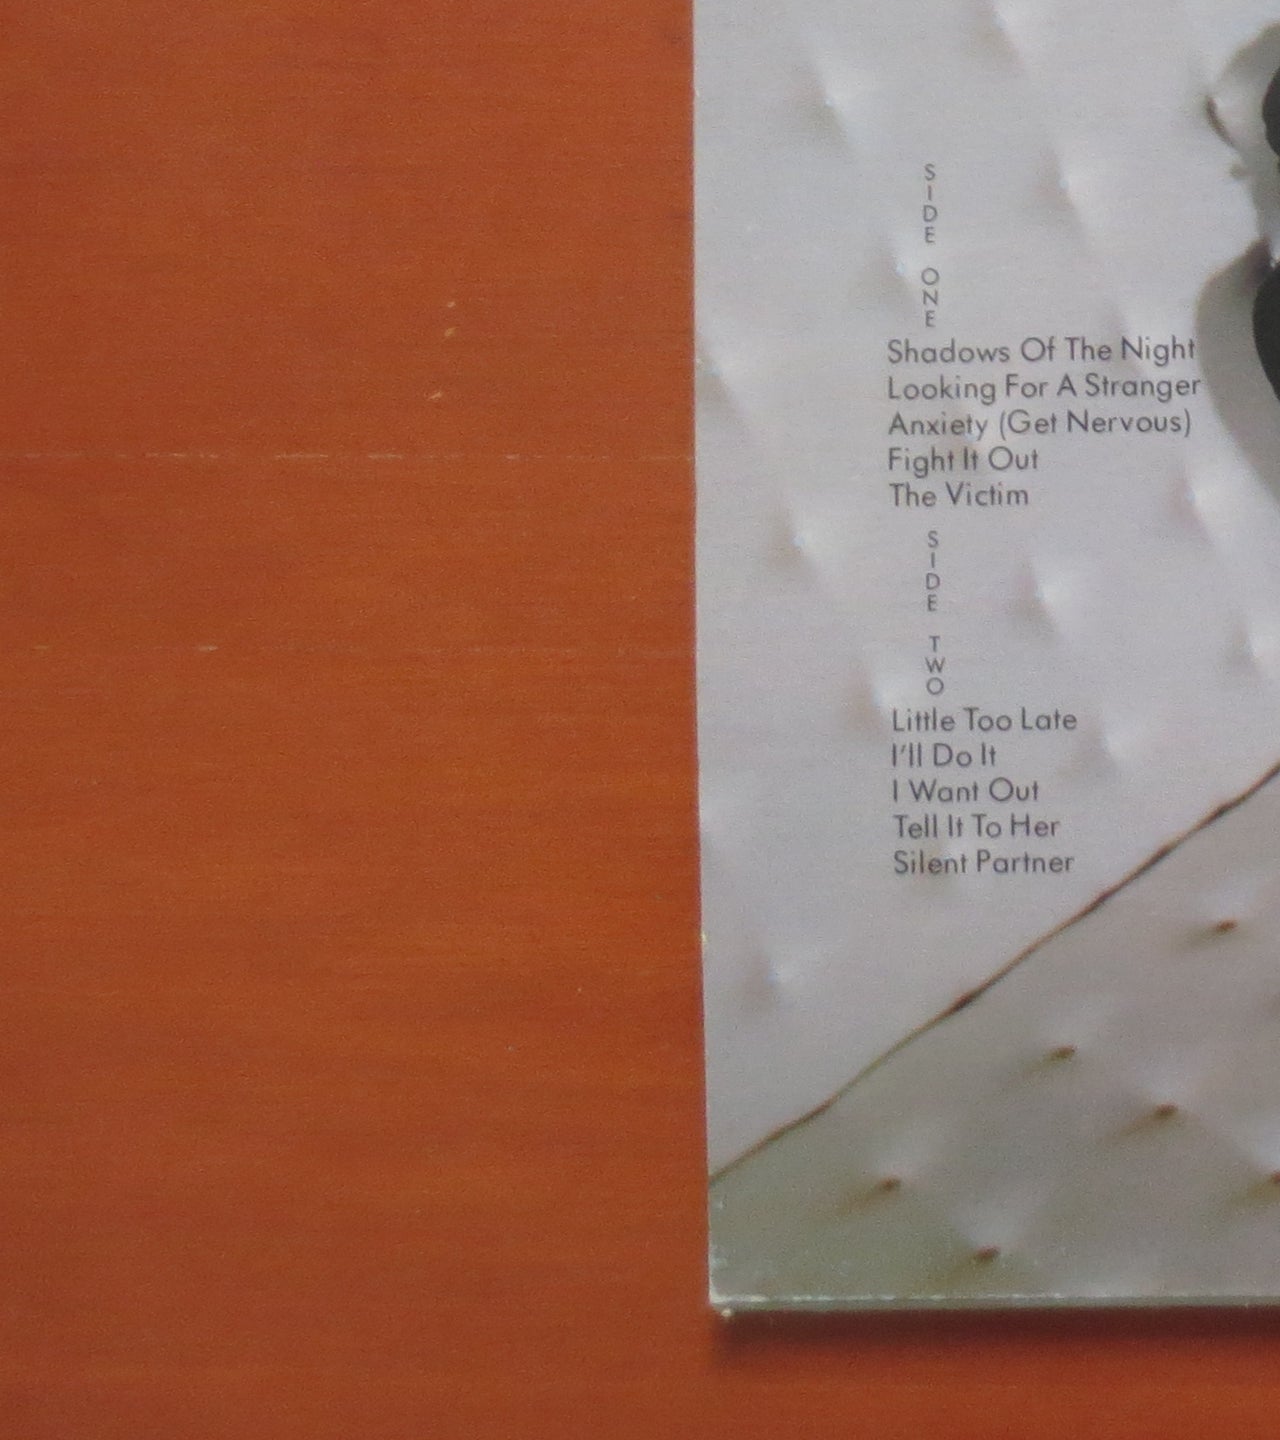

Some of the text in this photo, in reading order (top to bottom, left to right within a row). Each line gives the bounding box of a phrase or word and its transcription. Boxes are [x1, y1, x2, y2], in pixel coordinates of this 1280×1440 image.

[921, 163, 940, 328] SIDE ONE
[887, 335, 1195, 367] Shadows Of The Night
[887, 372, 1201, 406] Looking For A Stranger
[887, 408, 1192, 441] Anxiety (Get Nervous)
[887, 446, 1039, 479] Fight It Out
[889, 481, 1029, 508] The Victim
[925, 530, 945, 696] SIDE TWO
[891, 706, 1077, 732] Little Too Late
[891, 743, 997, 768] I'll Do It
[892, 776, 1039, 803] I Want Out
[893, 813, 1061, 839] Tell It To Her
[893, 849, 1075, 875] Silent Partner
